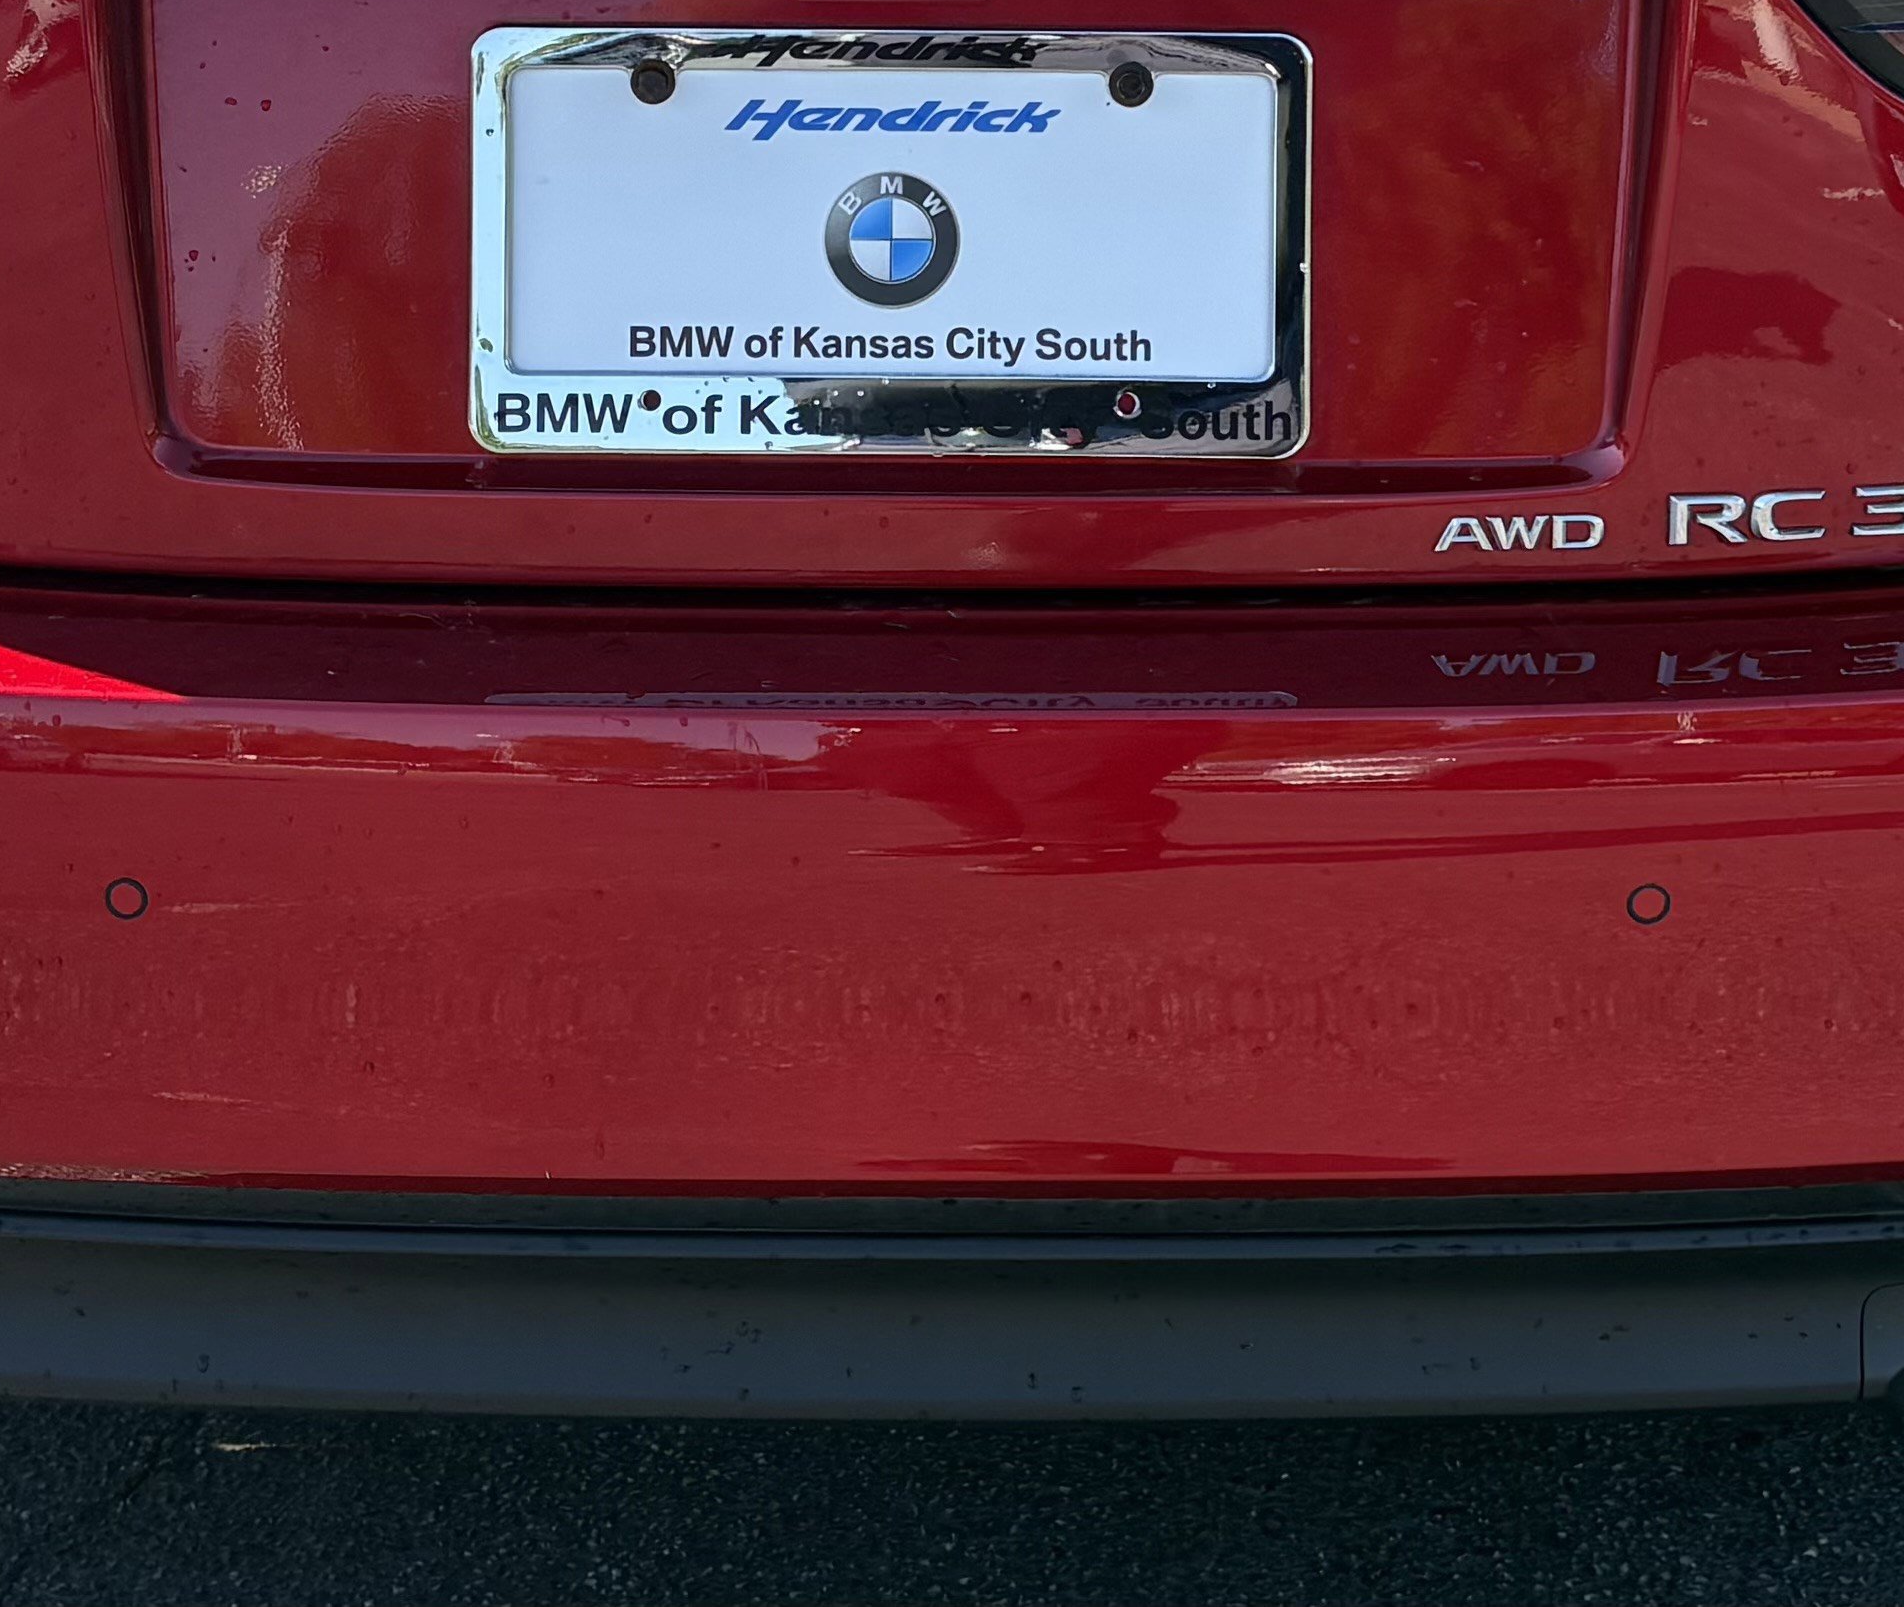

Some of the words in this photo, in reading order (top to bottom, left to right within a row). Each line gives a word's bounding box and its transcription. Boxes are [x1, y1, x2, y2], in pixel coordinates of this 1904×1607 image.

[711, 34, 1048, 68] Hendrick
[724, 99, 1063, 141] Hendrick
[838, 176, 946, 216] BMW
[629, 326, 734, 358] BMW
[744, 325, 783, 359] of
[793, 326, 934, 360] Kansas
[946, 327, 1025, 367] City
[1035, 328, 1152, 362] South
[496, 392, 634, 433] BMW
[662, 394, 723, 435] of
[1434, 514, 1605, 552] AWD
[1667, 490, 1827, 546] RC
